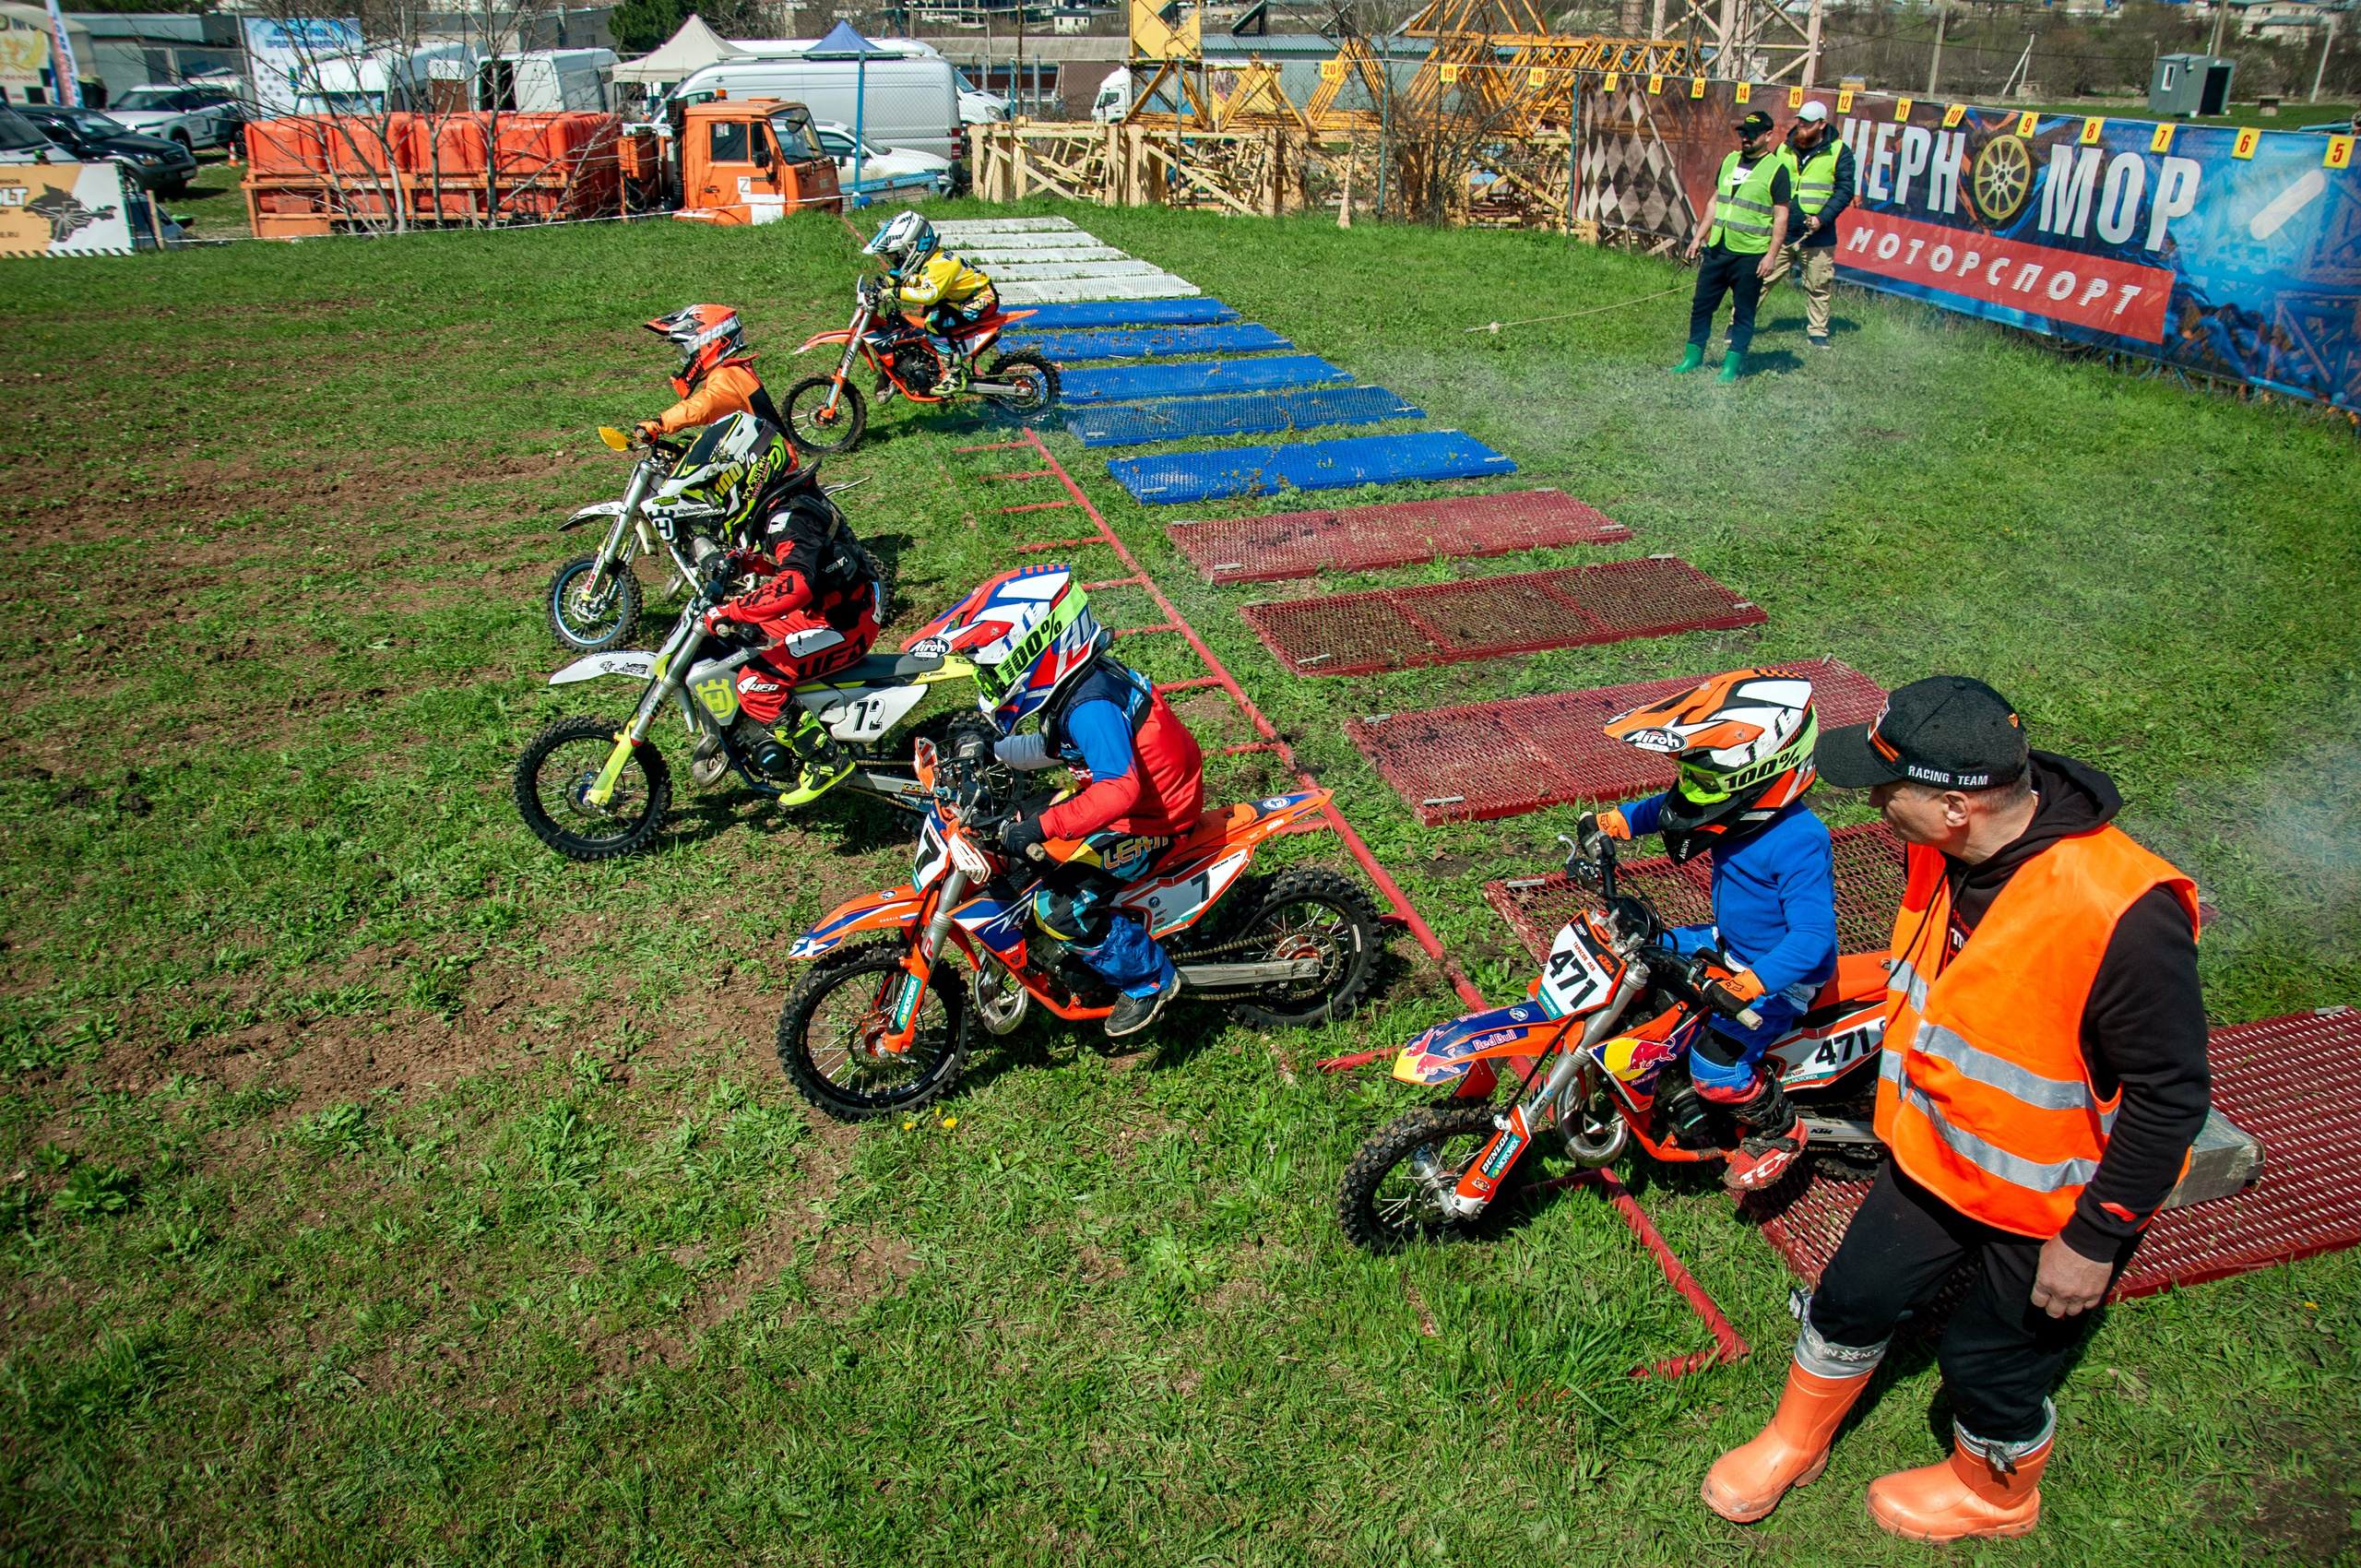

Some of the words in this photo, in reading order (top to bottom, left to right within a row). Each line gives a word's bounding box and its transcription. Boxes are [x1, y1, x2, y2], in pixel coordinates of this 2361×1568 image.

[1323, 64, 1336, 76] 20
[1443, 67, 1454, 79] 19
[1532, 72, 1543, 83] 18
[1608, 77, 1616, 89] 17
[1652, 79, 1660, 91] 16
[1694, 82, 1703, 96] 15
[1739, 88, 1748, 101] 14
[1792, 91, 1800, 105] 13
[1840, 96, 1850, 109] 12
[1898, 103, 1908, 117] 11
[1947, 110, 1962, 124] 10
[2022, 117, 2033, 134] 9
[2085, 122, 2096, 139] 8
[2157, 129, 2167, 148] 7
[2238, 135, 2252, 154] 6
[2331, 142, 2344, 163] 5
[2037, 144, 2201, 252] МОР
[1846, 227, 2143, 315] МОТОРСПОРТ
[690, 318, 736, 350] 100%
[715, 450, 758, 497] 100%
[909, 638, 946, 654] Airoh
[1001, 612, 1062, 681] 100%
[853, 698, 887, 733] 72
[1625, 730, 1680, 748] Airoh
[1724, 747, 1800, 790] 100%
[1908, 766, 1951, 783] RACING
[1957, 775, 1988, 786] TEAM
[1679, 838, 1691, 860] AIROH
[1190, 870, 1210, 903] 7
[879, 915, 899, 923] RUSSIA
[1572, 941, 1588, 962] ТАРАСОВ
[1596, 954, 1616, 975] KTM
[1549, 949, 1598, 1009] 471
[902, 978, 919, 1015] MOTOREX
[1472, 1034, 1497, 1051] Red
[1494, 1028, 1517, 1045] Bull
[1815, 1027, 1872, 1066] 471
[1791, 1074, 1819, 1084] MOTOREX
[1533, 1096, 1548, 1113] XACT
[1809, 1127, 1833, 1135] KTM
[1496, 1137, 1521, 1170] MOTOREX
[1739, 1152, 1792, 1184] TCX
